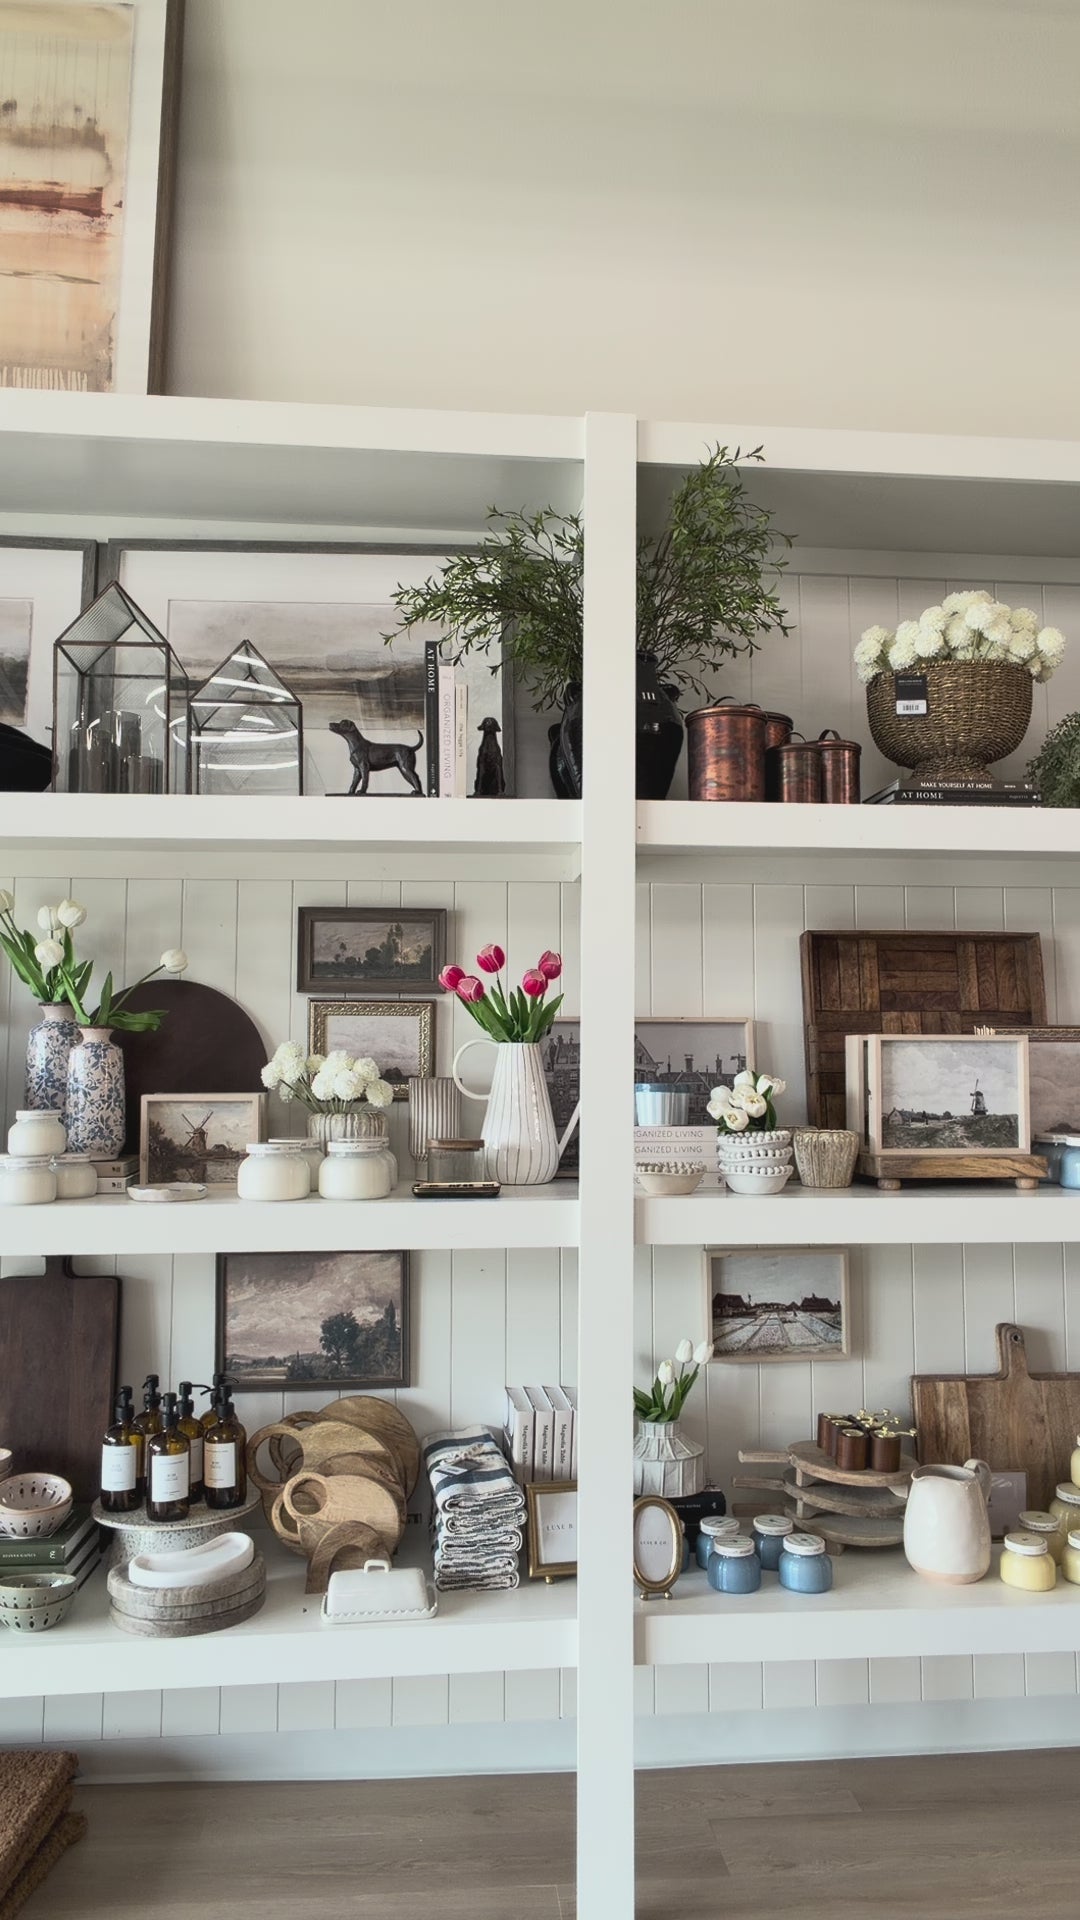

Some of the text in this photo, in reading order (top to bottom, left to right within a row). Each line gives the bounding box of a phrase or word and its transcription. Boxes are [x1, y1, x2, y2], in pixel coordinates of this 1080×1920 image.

[427, 648, 436, 693] AT HOME
[443, 693, 452, 779] ORGANIZED LIVING
[901, 791, 914, 799] AT
[916, 791, 944, 799] HOME
[634, 1130, 704, 1138] GANIZED LIVING
